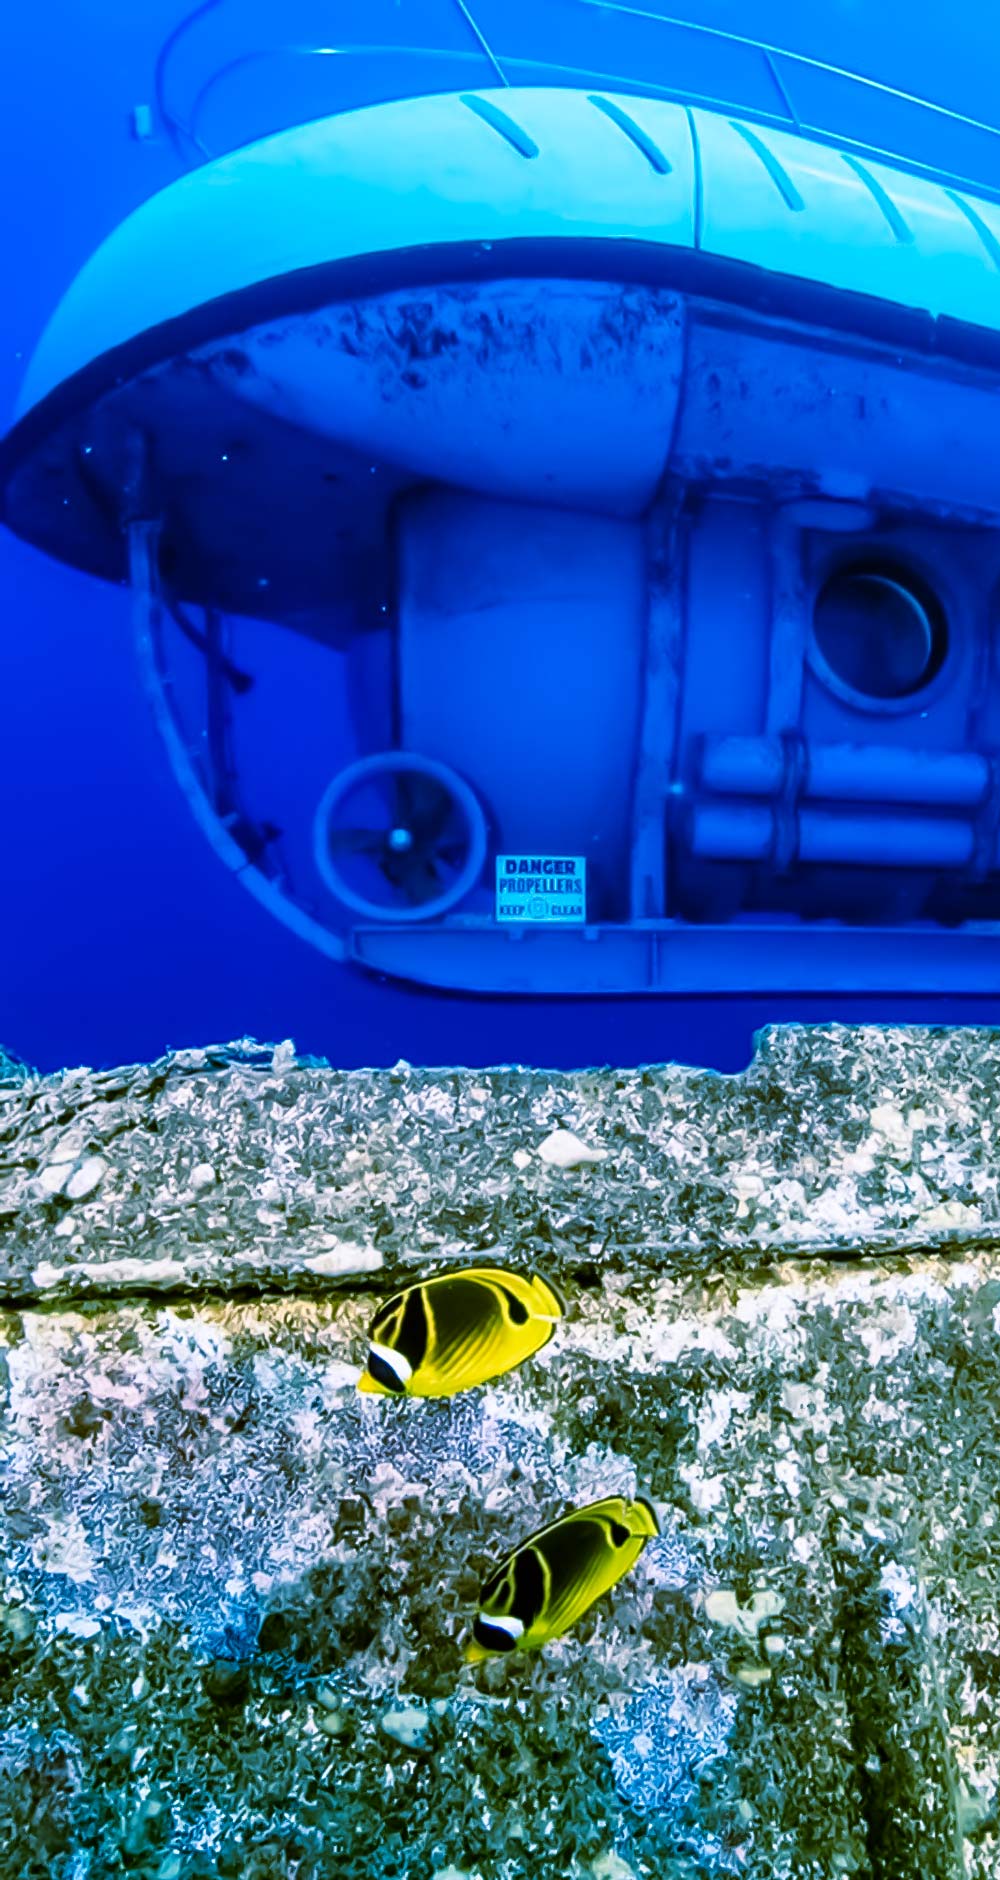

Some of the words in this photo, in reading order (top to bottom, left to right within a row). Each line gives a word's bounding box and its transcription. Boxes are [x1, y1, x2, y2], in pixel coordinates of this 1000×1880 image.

[505, 859, 576, 875] DANGER
[499, 878, 583, 894] PROPELLERS
[500, 905, 525, 915] KEEP
[551, 905, 582, 916] CLEAR
